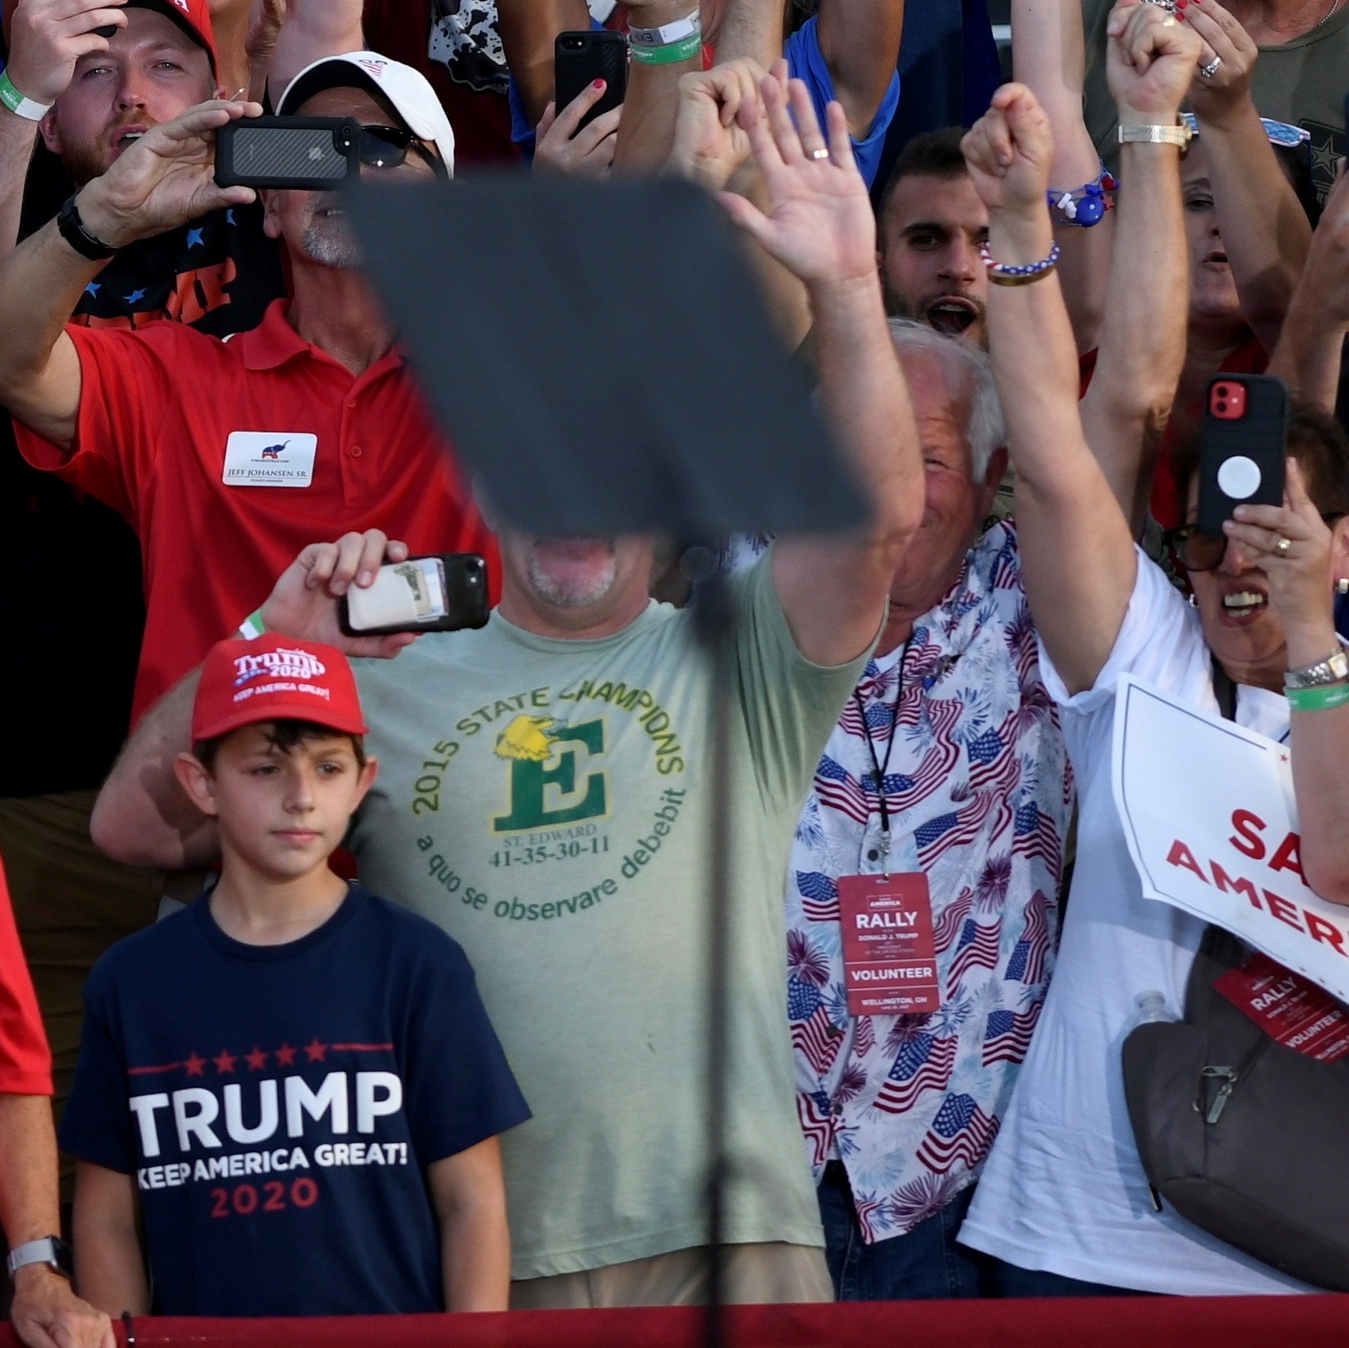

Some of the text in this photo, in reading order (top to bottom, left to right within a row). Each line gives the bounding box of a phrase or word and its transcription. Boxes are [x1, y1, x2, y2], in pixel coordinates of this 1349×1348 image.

[227, 468, 248, 478] JEFF
[247, 468, 296, 478] JOHANSEN
[234, 652, 326, 678] Trump
[270, 664, 312, 680] 2020
[254, 682, 297, 696] AMERICA
[412, 679, 685, 815] 2015 STATE CHAMPIONS
[491, 717, 609, 834] E
[488, 835, 610, 869] 41-35-30-11
[529, 822, 598, 845] EDWARD
[1229, 807, 1311, 889] SA
[416, 786, 687, 921] a quo se observare debebit
[1166, 839, 1349, 959] AMER
[855, 911, 918, 929] RALLY
[851, 967, 933, 982] VOLUNTEER
[1249, 976, 1298, 1011] RALLY
[1285, 1008, 1343, 1049] VOLUNTEER
[128, 1070, 403, 1158] TRUMP
[137, 1140, 407, 1191] KEEP AMERICA GREAT!
[211, 1177, 319, 1220] 2020
